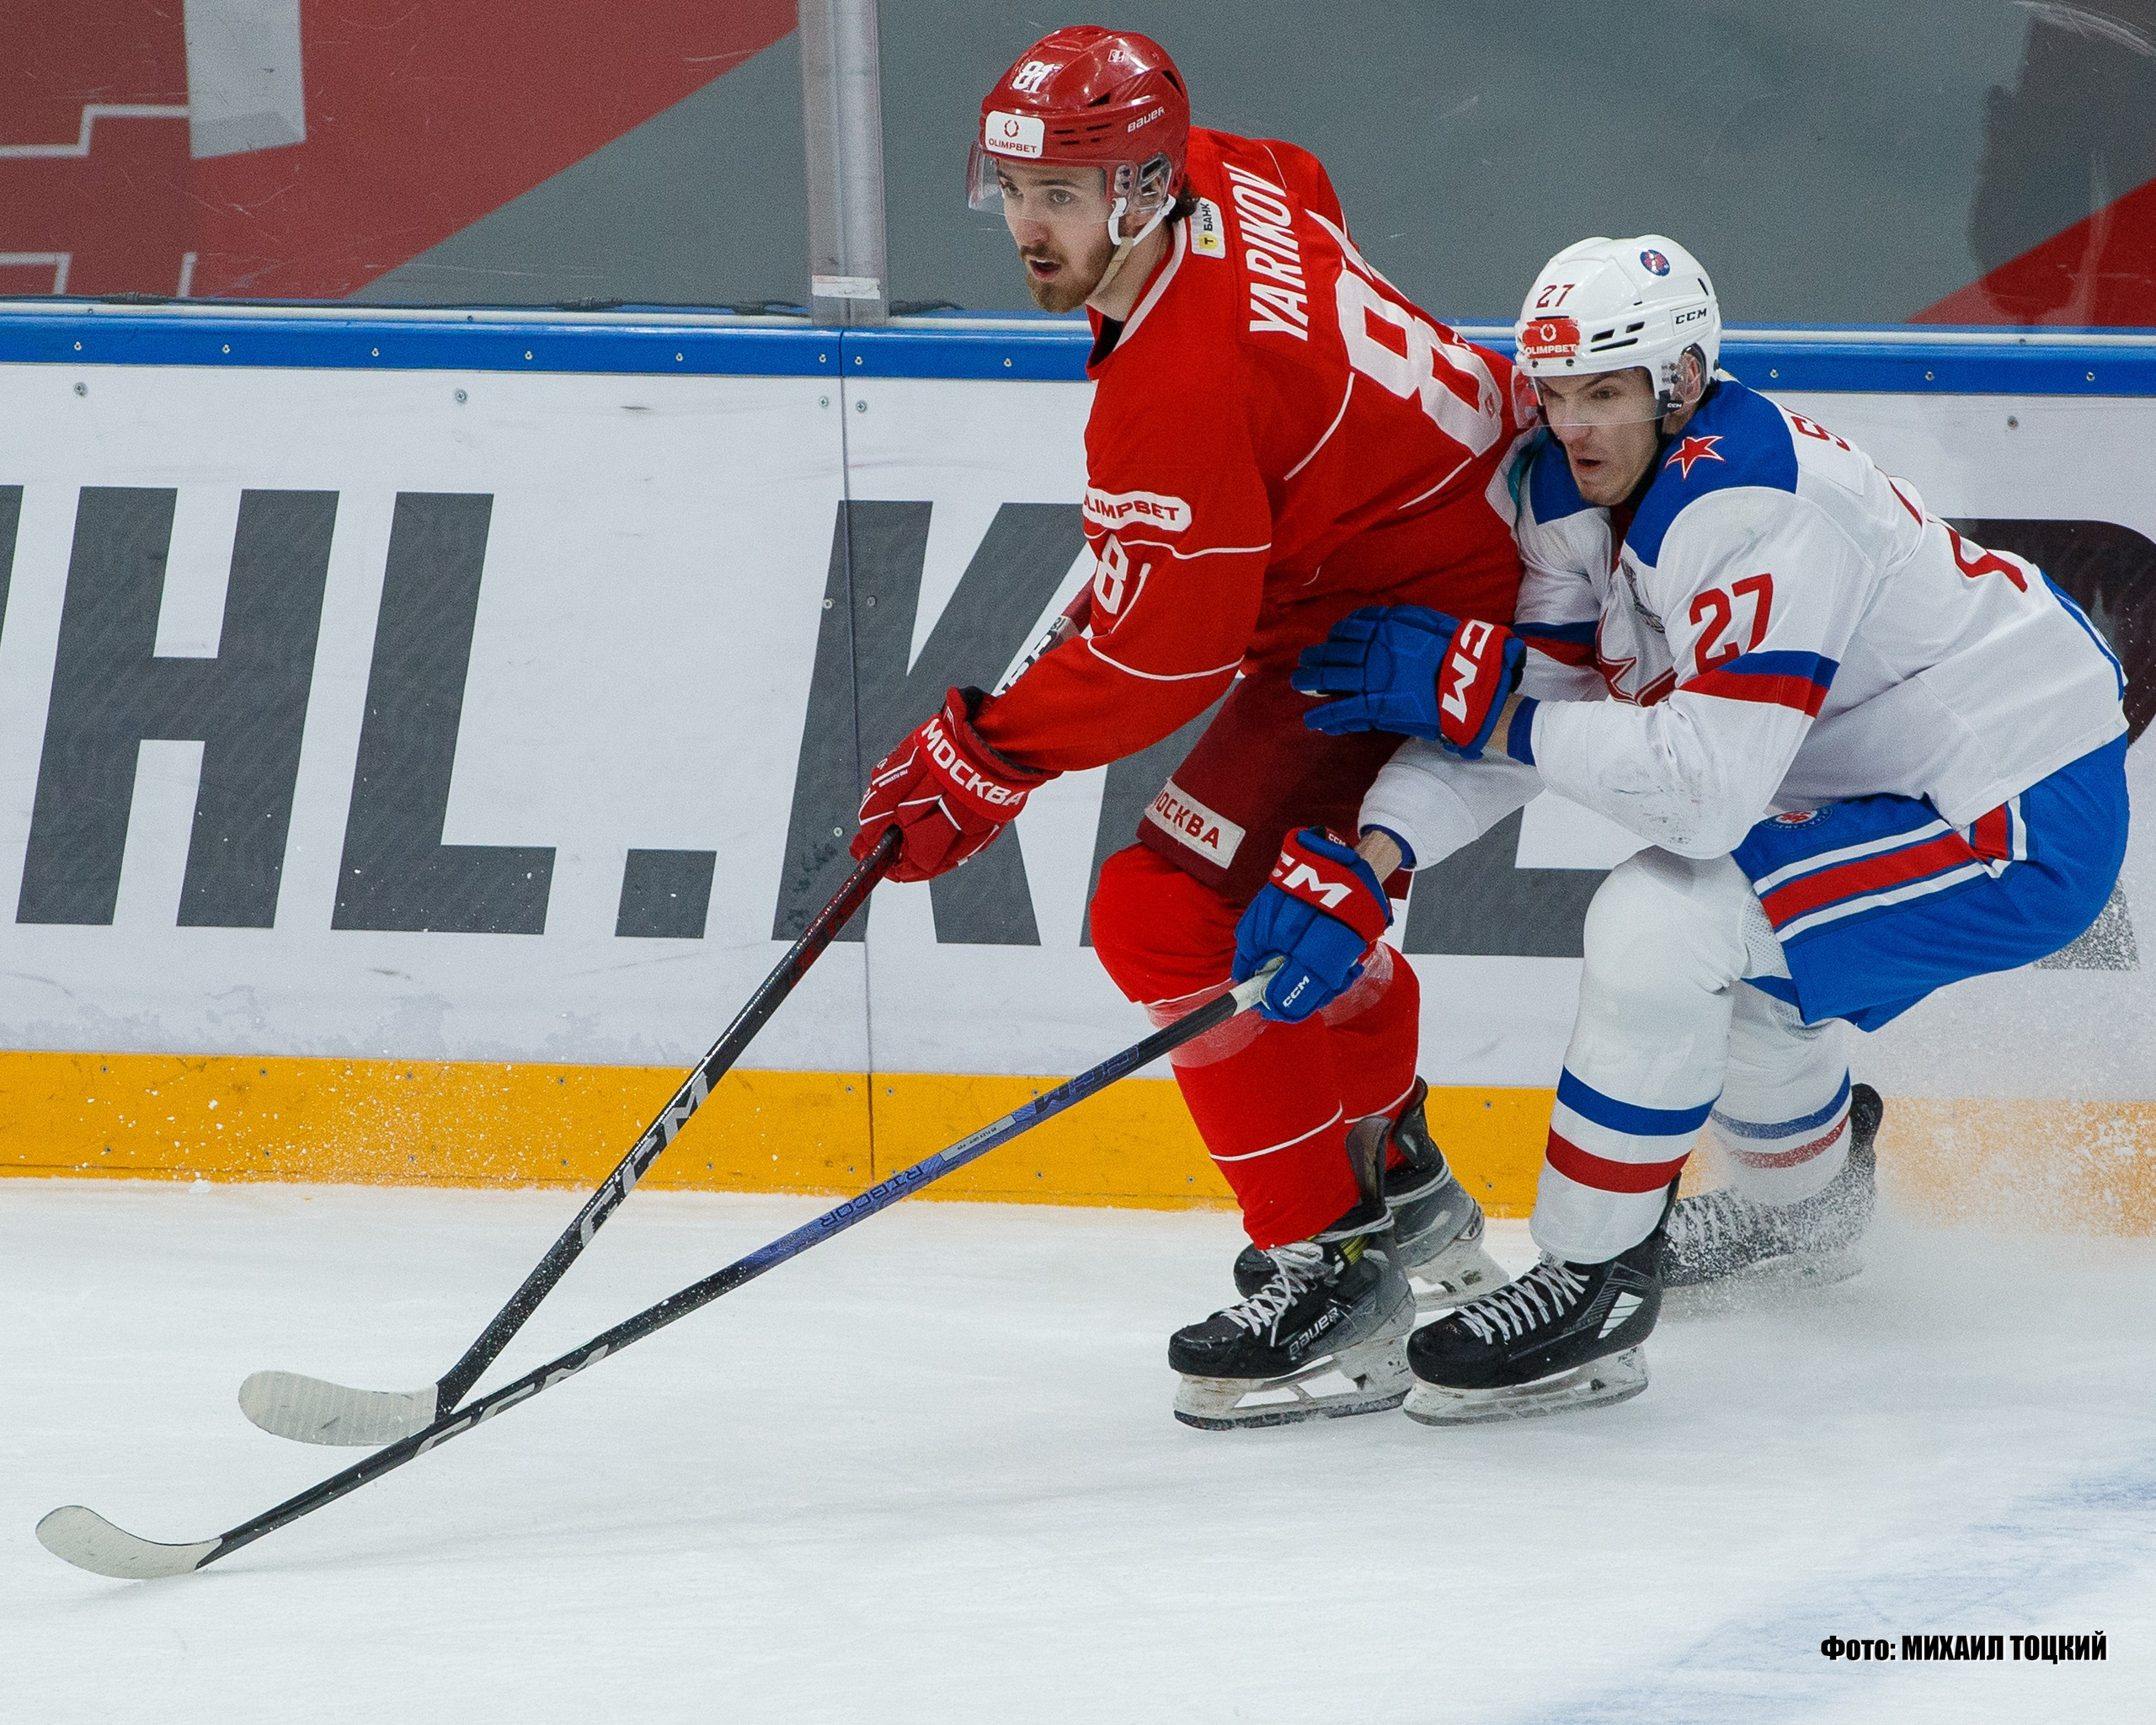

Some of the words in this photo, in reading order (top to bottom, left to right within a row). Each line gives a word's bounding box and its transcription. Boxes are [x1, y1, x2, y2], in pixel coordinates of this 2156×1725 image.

[1011, 61, 1054, 93] 81
[1127, 106, 1166, 133] BAUER
[988, 137, 1038, 153] OLIMPBET
[1203, 202, 1214, 232] БАНК
[1222, 161, 1309, 342] YARIKOV
[1535, 283, 1576, 309] 27
[1674, 307, 1708, 325] CCM
[1524, 343, 1578, 356] OLIMPBET
[1667, 401, 1683, 410] CCM
[1689, 573, 1775, 675] 27
[1441, 619, 1495, 724] CM
[921, 718, 1027, 806] МОСКВА
[1154, 789, 1220, 850] ОСКВА
[1327, 832, 1347, 847] CCM
[1282, 975, 1310, 1008] CCM
[580, 1071, 710, 1247] CCM
[819, 1164, 926, 1229] RIBCOR
